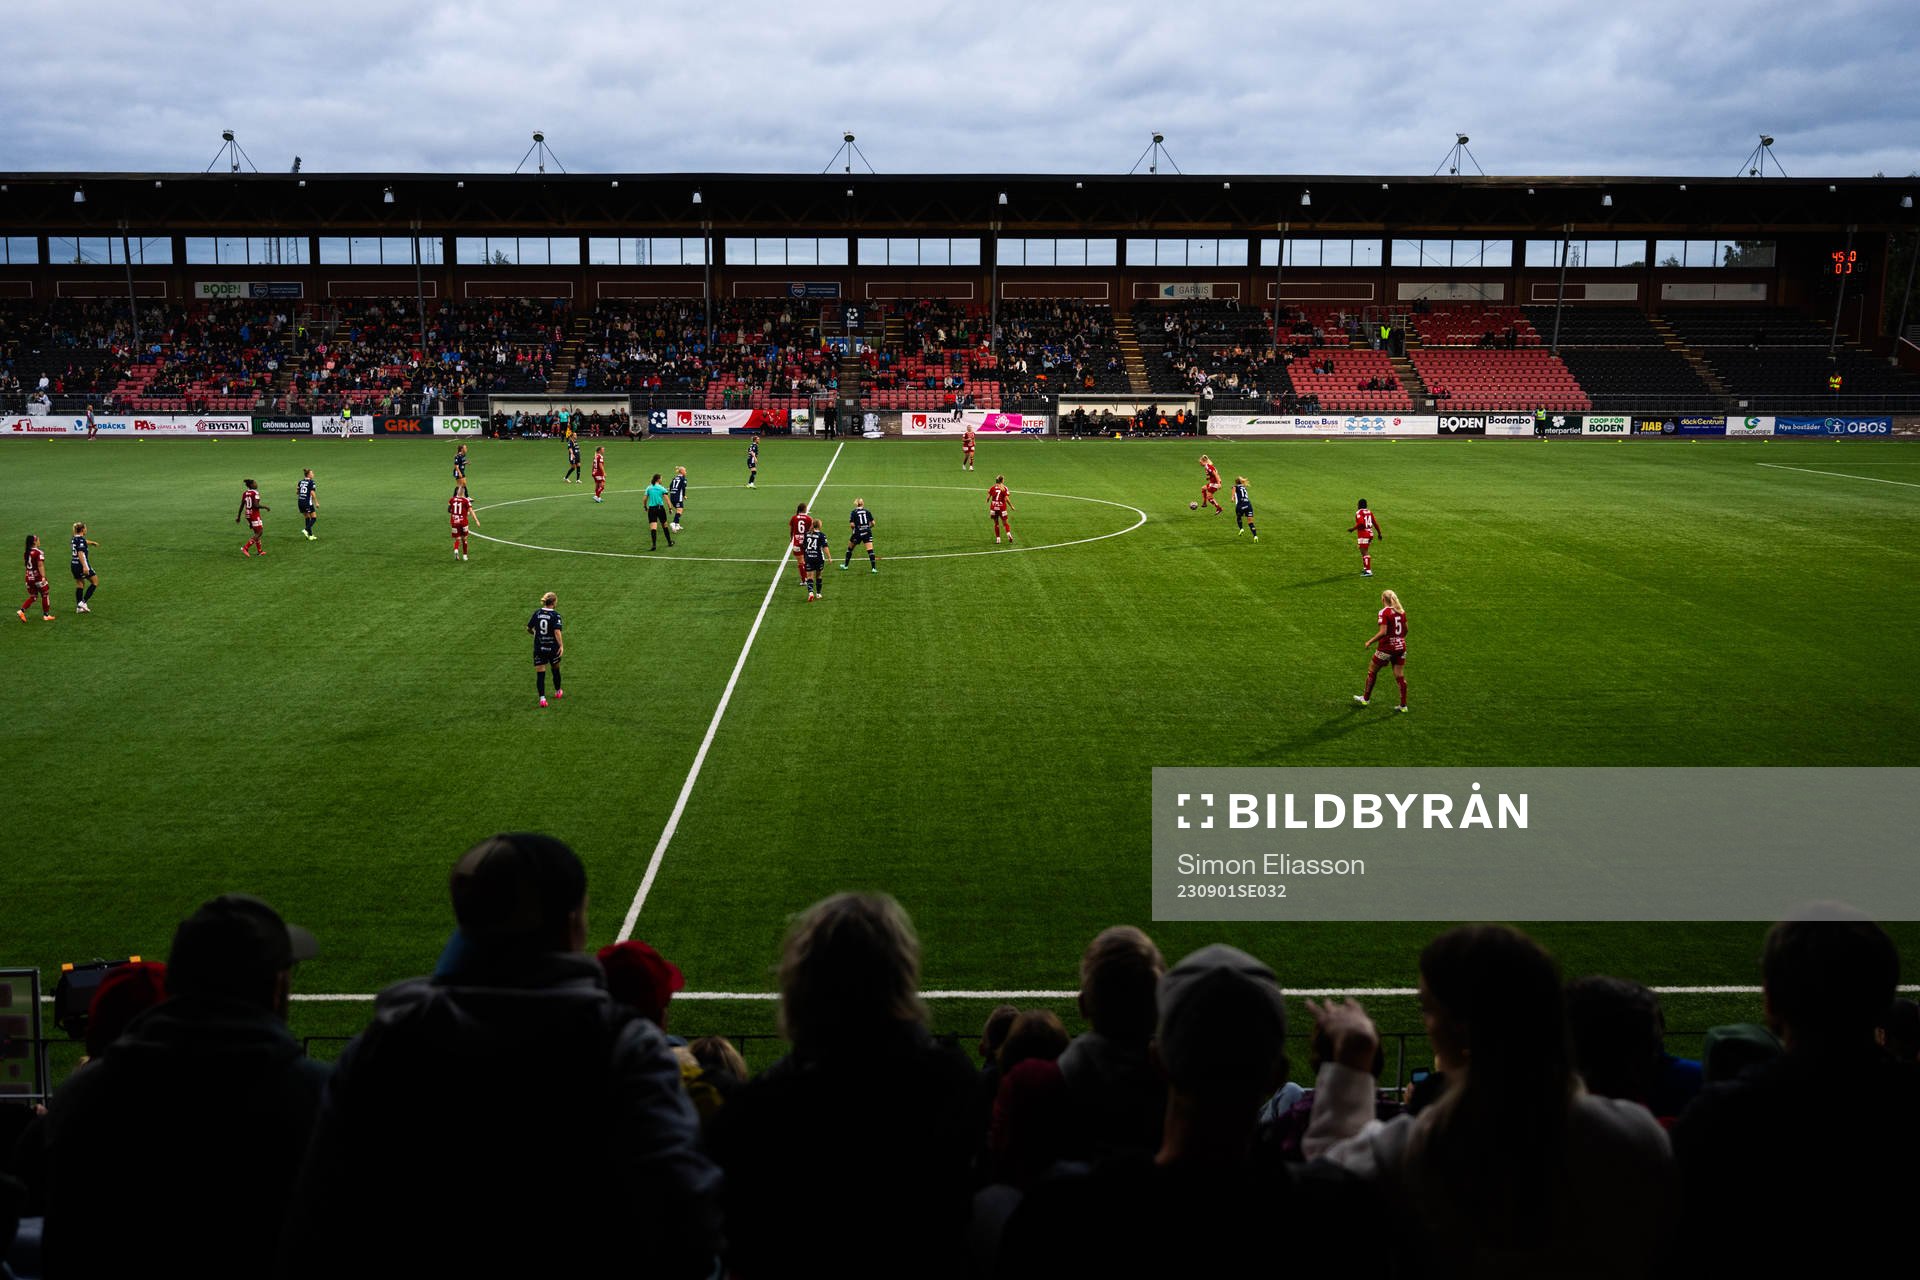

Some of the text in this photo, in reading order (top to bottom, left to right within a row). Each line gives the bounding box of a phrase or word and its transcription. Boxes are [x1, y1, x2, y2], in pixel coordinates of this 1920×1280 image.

[1178, 286, 1209, 295] GARNIS
[384, 420, 422, 432] GRK
[1440, 417, 1483, 432] BODEN
[1488, 416, 1531, 425] Bodenbo
[1641, 421, 1662, 431] JIAB
[1589, 424, 1624, 432] BODEN
[1779, 423, 1791, 431] Nya
[1847, 422, 1887, 433] OBOS
[672, 480, 681, 489] 17
[995, 489, 1001, 501] 7
[453, 501, 462, 514] 11
[858, 513, 868, 525] 11
[1363, 514, 1373, 528] 14
[798, 520, 805, 533] 6
[807, 537, 818, 550] 24
[540, 619, 548, 635] 9
[1394, 615, 1402, 636] 5
